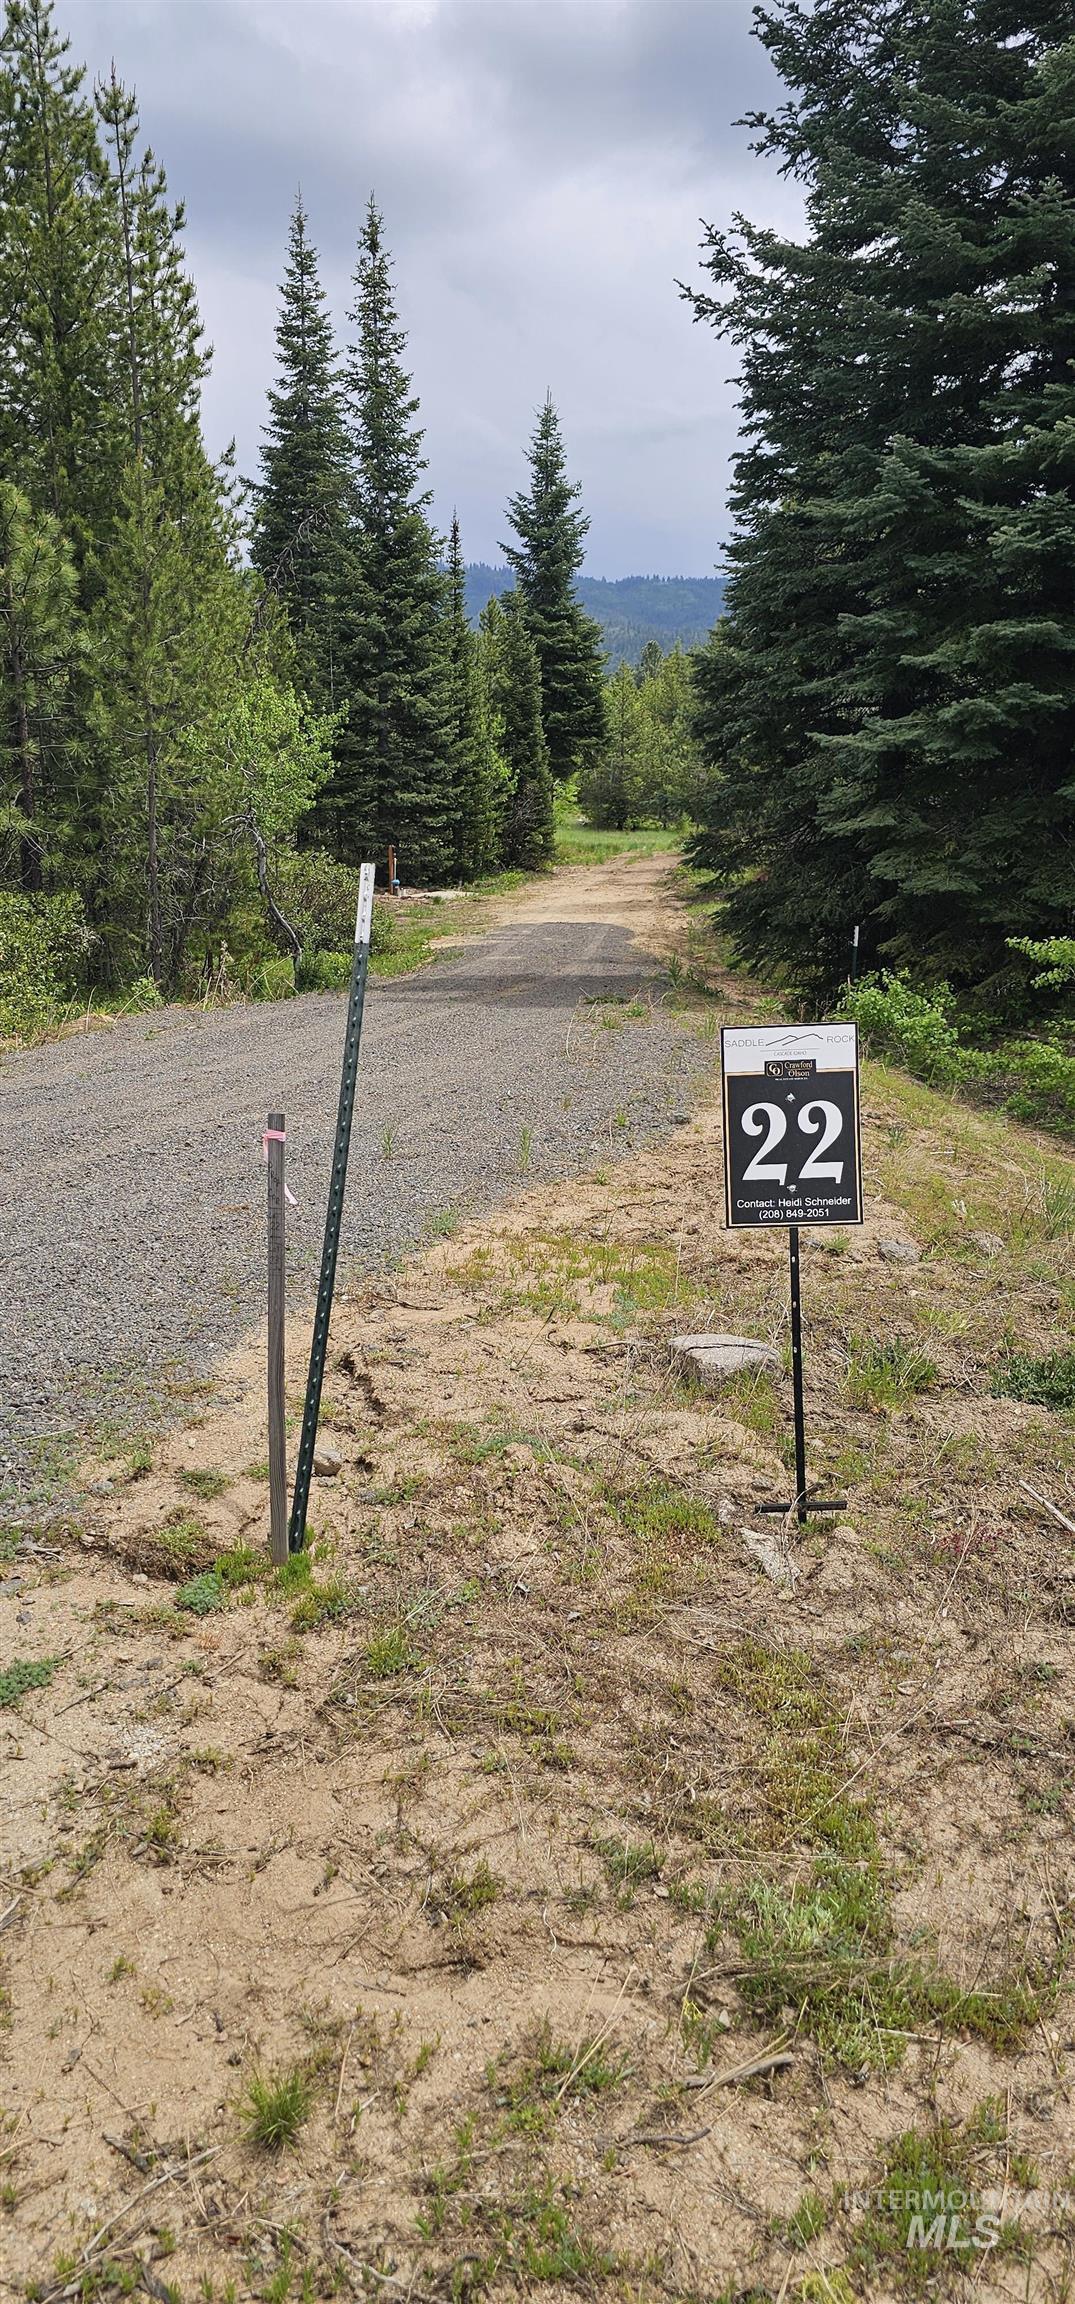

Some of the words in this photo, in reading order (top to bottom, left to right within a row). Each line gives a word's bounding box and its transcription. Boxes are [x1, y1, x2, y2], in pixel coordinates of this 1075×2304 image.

[724, 1038, 765, 1048] SADDLE
[826, 1034, 856, 1044] ROCK
[784, 1060, 813, 1070] Crawford
[788, 1069, 810, 1078] Olson
[741, 1100, 844, 1186] 22
[736, 1199, 776, 1209] Contact:
[778, 1197, 802, 1207] Heidi
[804, 1195, 852, 1206] Schneider
[758, 1210, 784, 1221] (208)
[786, 1208, 830, 1218] 849-2051
